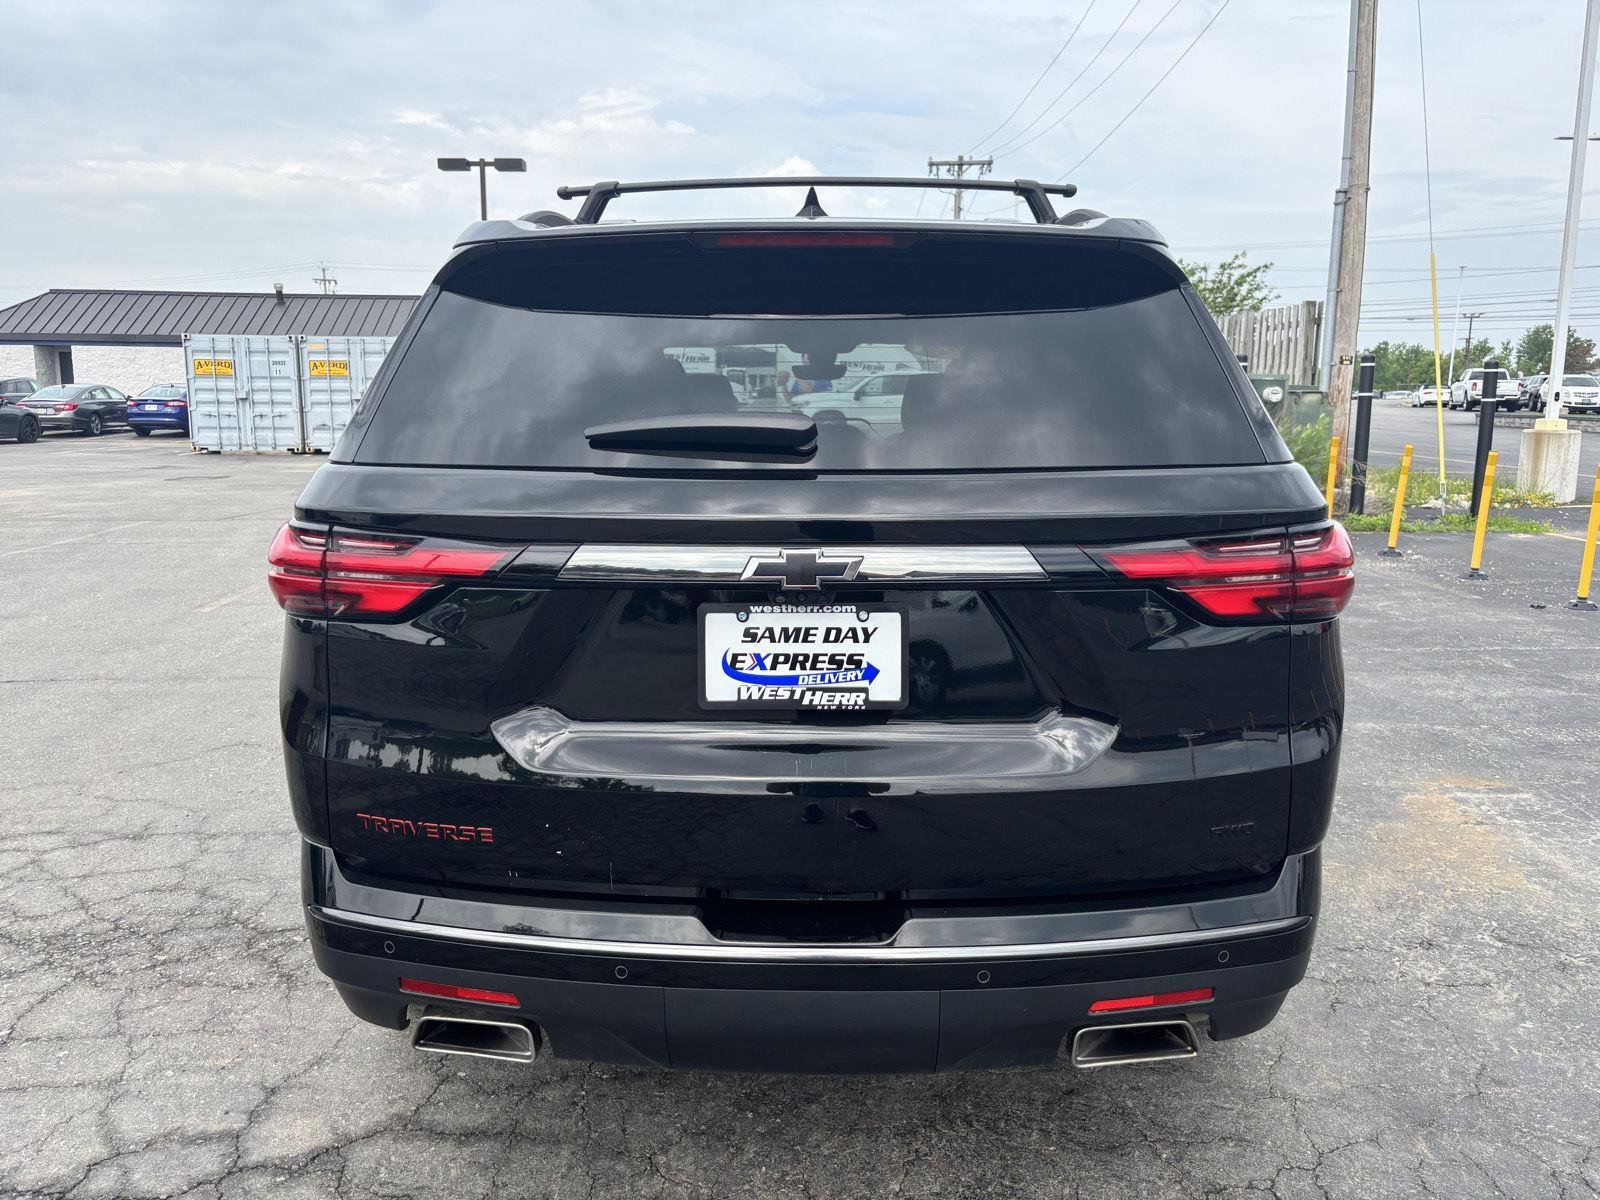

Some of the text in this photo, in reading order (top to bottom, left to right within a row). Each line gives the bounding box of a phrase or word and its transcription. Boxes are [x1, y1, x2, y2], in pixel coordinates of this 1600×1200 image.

[749, 604, 857, 614] westherr.com
[741, 626, 879, 644] SAME DAY
[729, 652, 865, 671] EXPRESS
[798, 669, 865, 685] DELIVERY
[738, 685, 867, 705] WEST HERR
[356, 812, 495, 844] TRAVERSE
